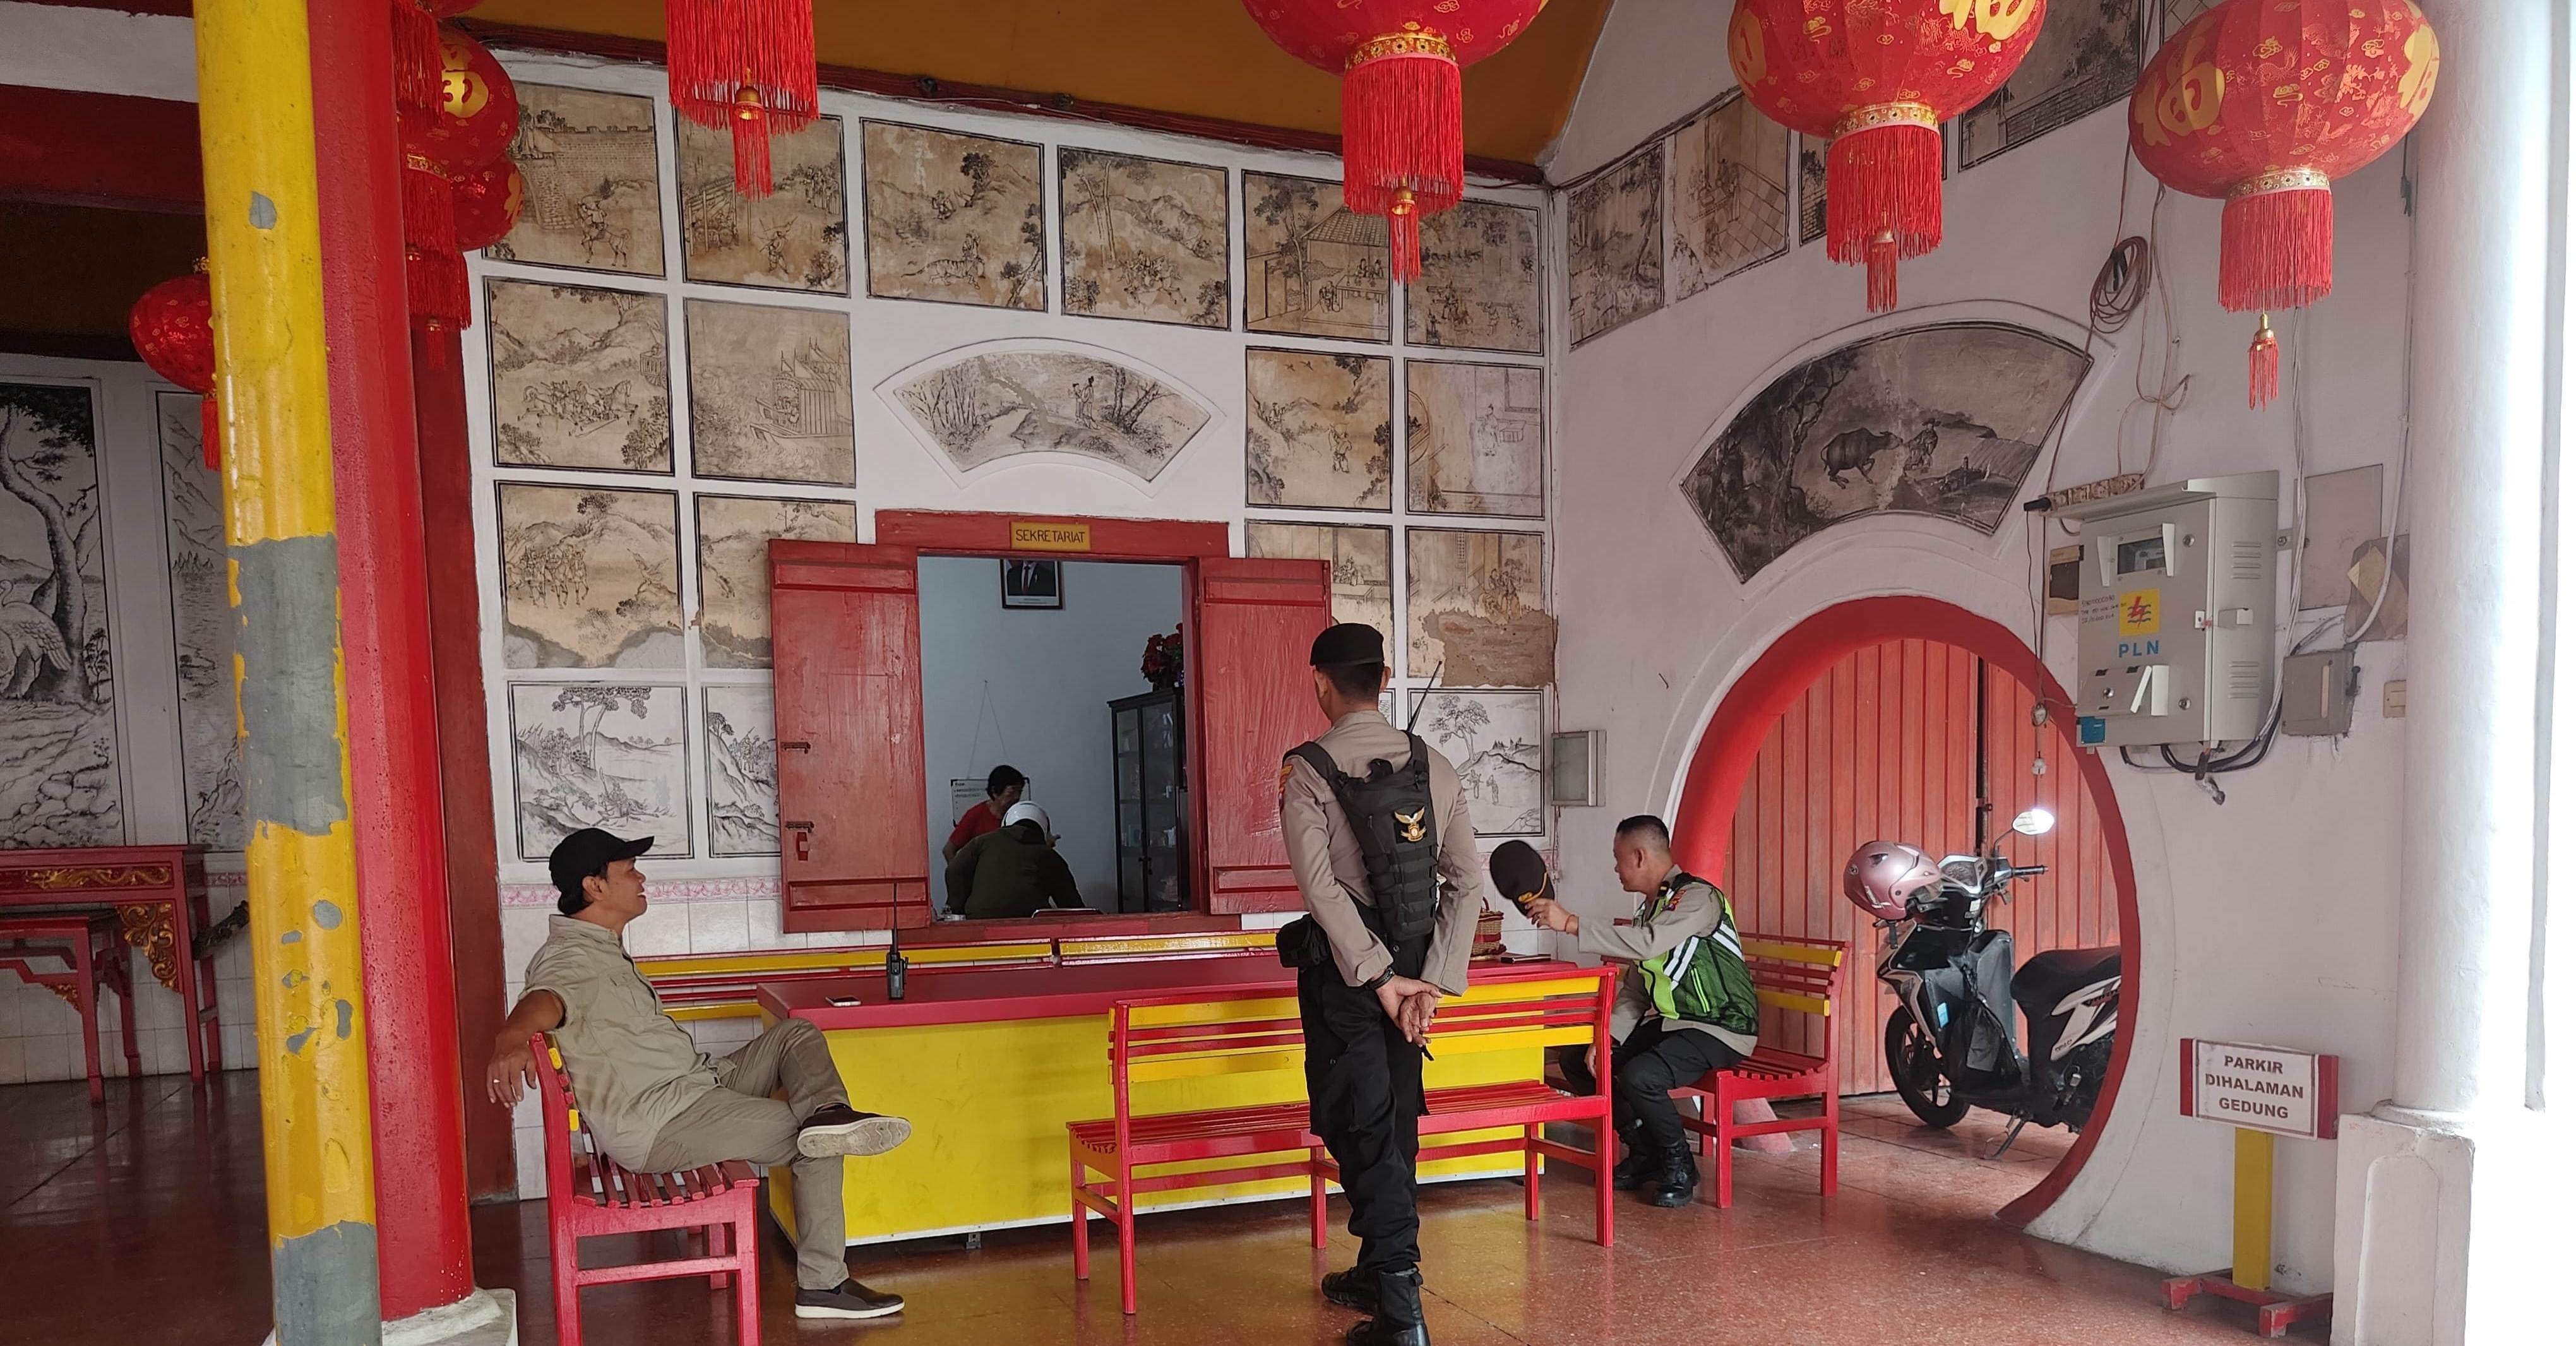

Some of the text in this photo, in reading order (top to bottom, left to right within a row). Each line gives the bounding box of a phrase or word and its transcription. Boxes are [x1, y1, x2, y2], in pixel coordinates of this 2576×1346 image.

[1015, 528, 1086, 544] SEKRETARIAT
[2118, 640, 2159, 658] PLN
[2224, 1055, 2284, 1075] PARKIR
[2205, 1073, 2304, 1099] DIHALAMAN
[2219, 1097, 2289, 1119] GEDUNG
